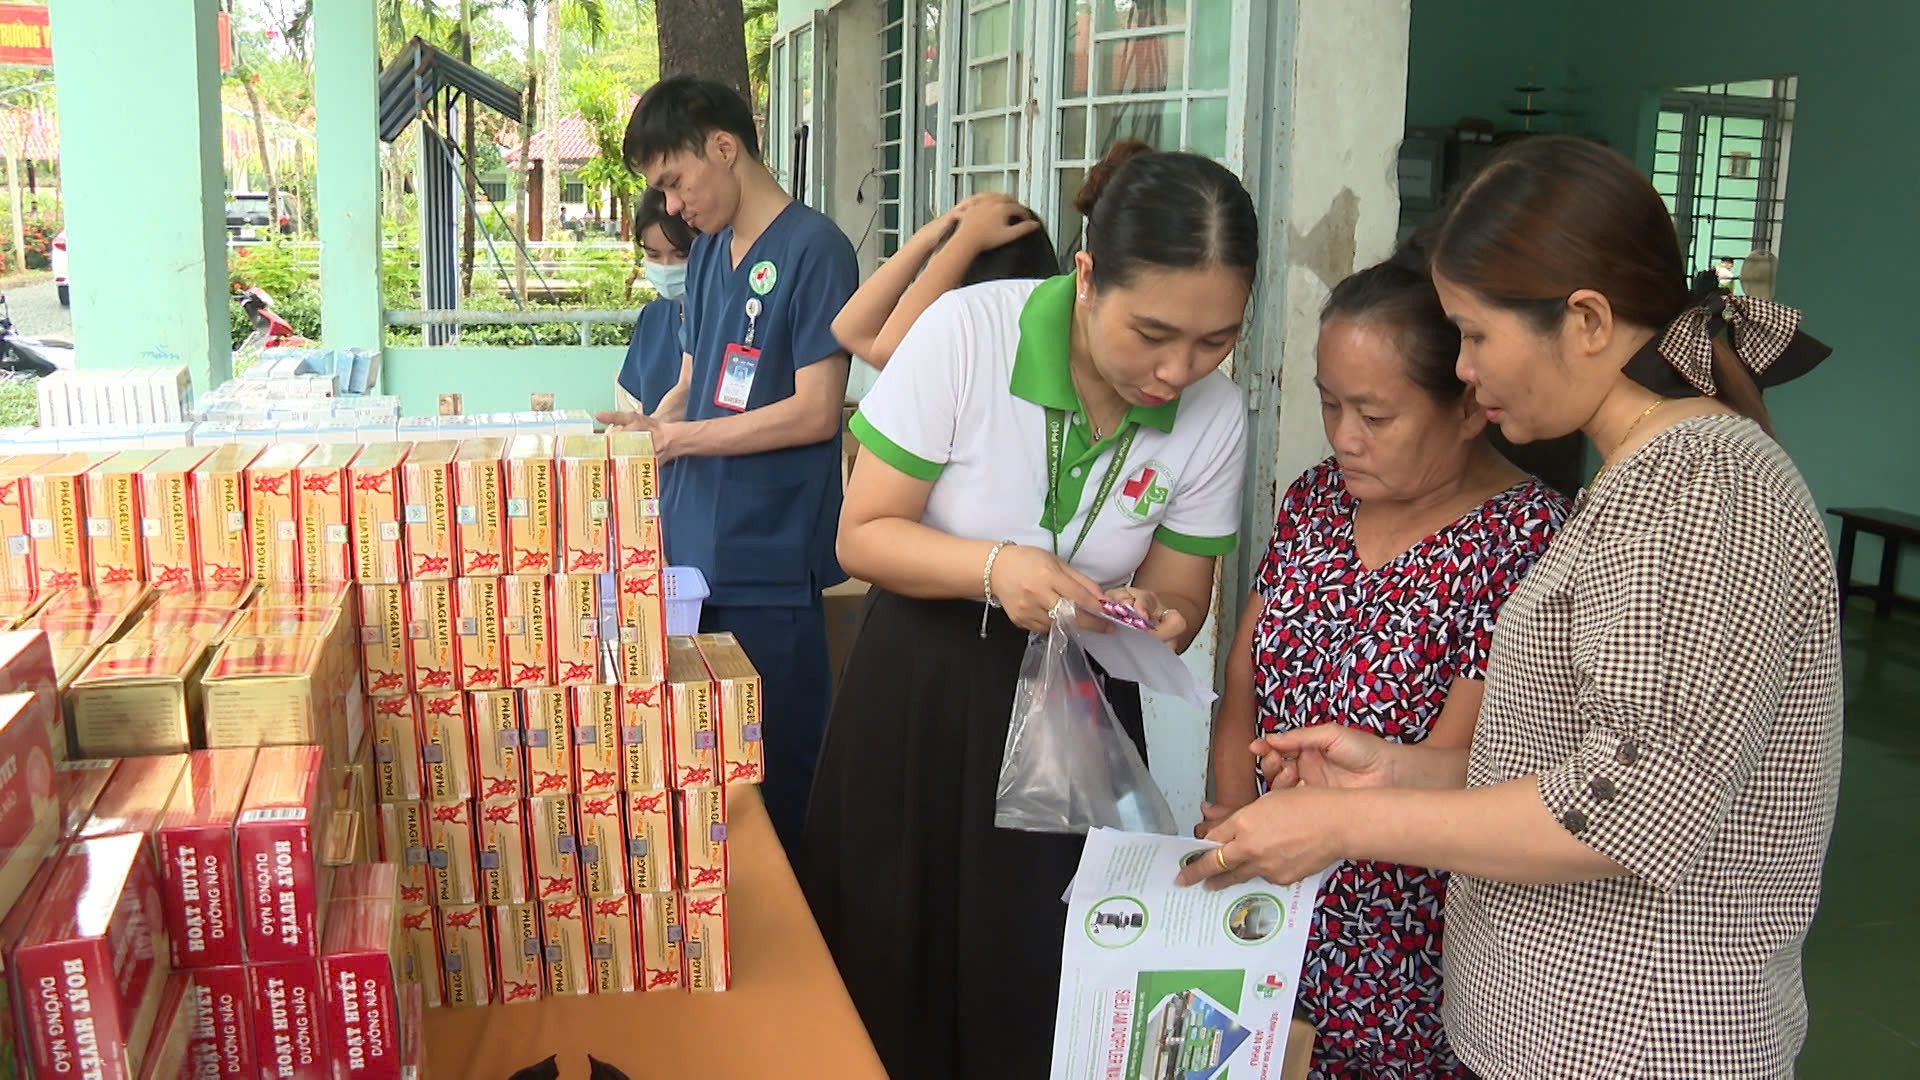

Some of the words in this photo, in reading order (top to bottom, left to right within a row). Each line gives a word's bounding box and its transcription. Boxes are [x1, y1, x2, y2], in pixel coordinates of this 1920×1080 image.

[0, 18, 41, 48] RƯỜNG
[60, 481, 74, 545] PHAGELVIT
[118, 479, 130, 543] PHAGELVIT
[171, 479, 185, 542] PHAGELVIT
[224, 479, 237, 540] PHAGT
[434, 468, 445, 531] PHAGELVIT
[485, 466, 496, 528] PHAGELVIT
[537, 465, 547, 527] PHAGELVIT
[592, 467, 602, 527] PHAGIT
[642, 463, 653, 525] PHAGT
[256, 517, 267, 580] PHAGELVIT
[359, 516, 370, 578] PHAGELVIT
[388, 588, 401, 649] PHAGELVIT
[436, 585, 448, 646] PHAGELVIT
[484, 583, 496, 644] PHAGELVIT
[532, 581, 543, 642] PHAGELVIT
[581, 581, 591, 639] PHAGET
[626, 618, 638, 676] PHAGIT
[501, 697, 513, 755] PHAGIT
[553, 693, 565, 750] PHAGELVIT
[603, 691, 614, 748] PHAGELVIT
[697, 689, 708, 731] PHAGEL
[381, 739, 394, 796] PHAGT
[431, 737, 445, 796] PHAGIT
[630, 744, 640, 784] PHAGEL
[711, 791, 720, 846] PHAGT
[176, 845, 200, 901] HUYẾT
[274, 840, 294, 887] HOẠT
[436, 845, 449, 900] PHAGT
[488, 845, 500, 900] PHAGIT
[587, 837, 599, 892] PHAGT
[635, 835, 647, 888] PHAGT
[185, 905, 205, 952] HOẠT
[279, 891, 302, 946] HUYẾT
[522, 909, 534, 962] PHAGIT
[666, 896, 676, 948] PHAGIT
[63, 957, 91, 1013] HOẠT
[552, 939, 564, 992] PHAGT
[598, 937, 609, 989] PHAGIT
[691, 936, 702, 988] PHAGIT
[39, 976, 64, 1036] DƯỠNG
[264, 977, 289, 1030] HUYẾT
[336, 970, 360, 1023] HUYẾT
[51, 1039, 71, 1073] NÃO
[274, 1034, 294, 1078] HOẠT
[346, 1027, 366, 1070] HOẠT
